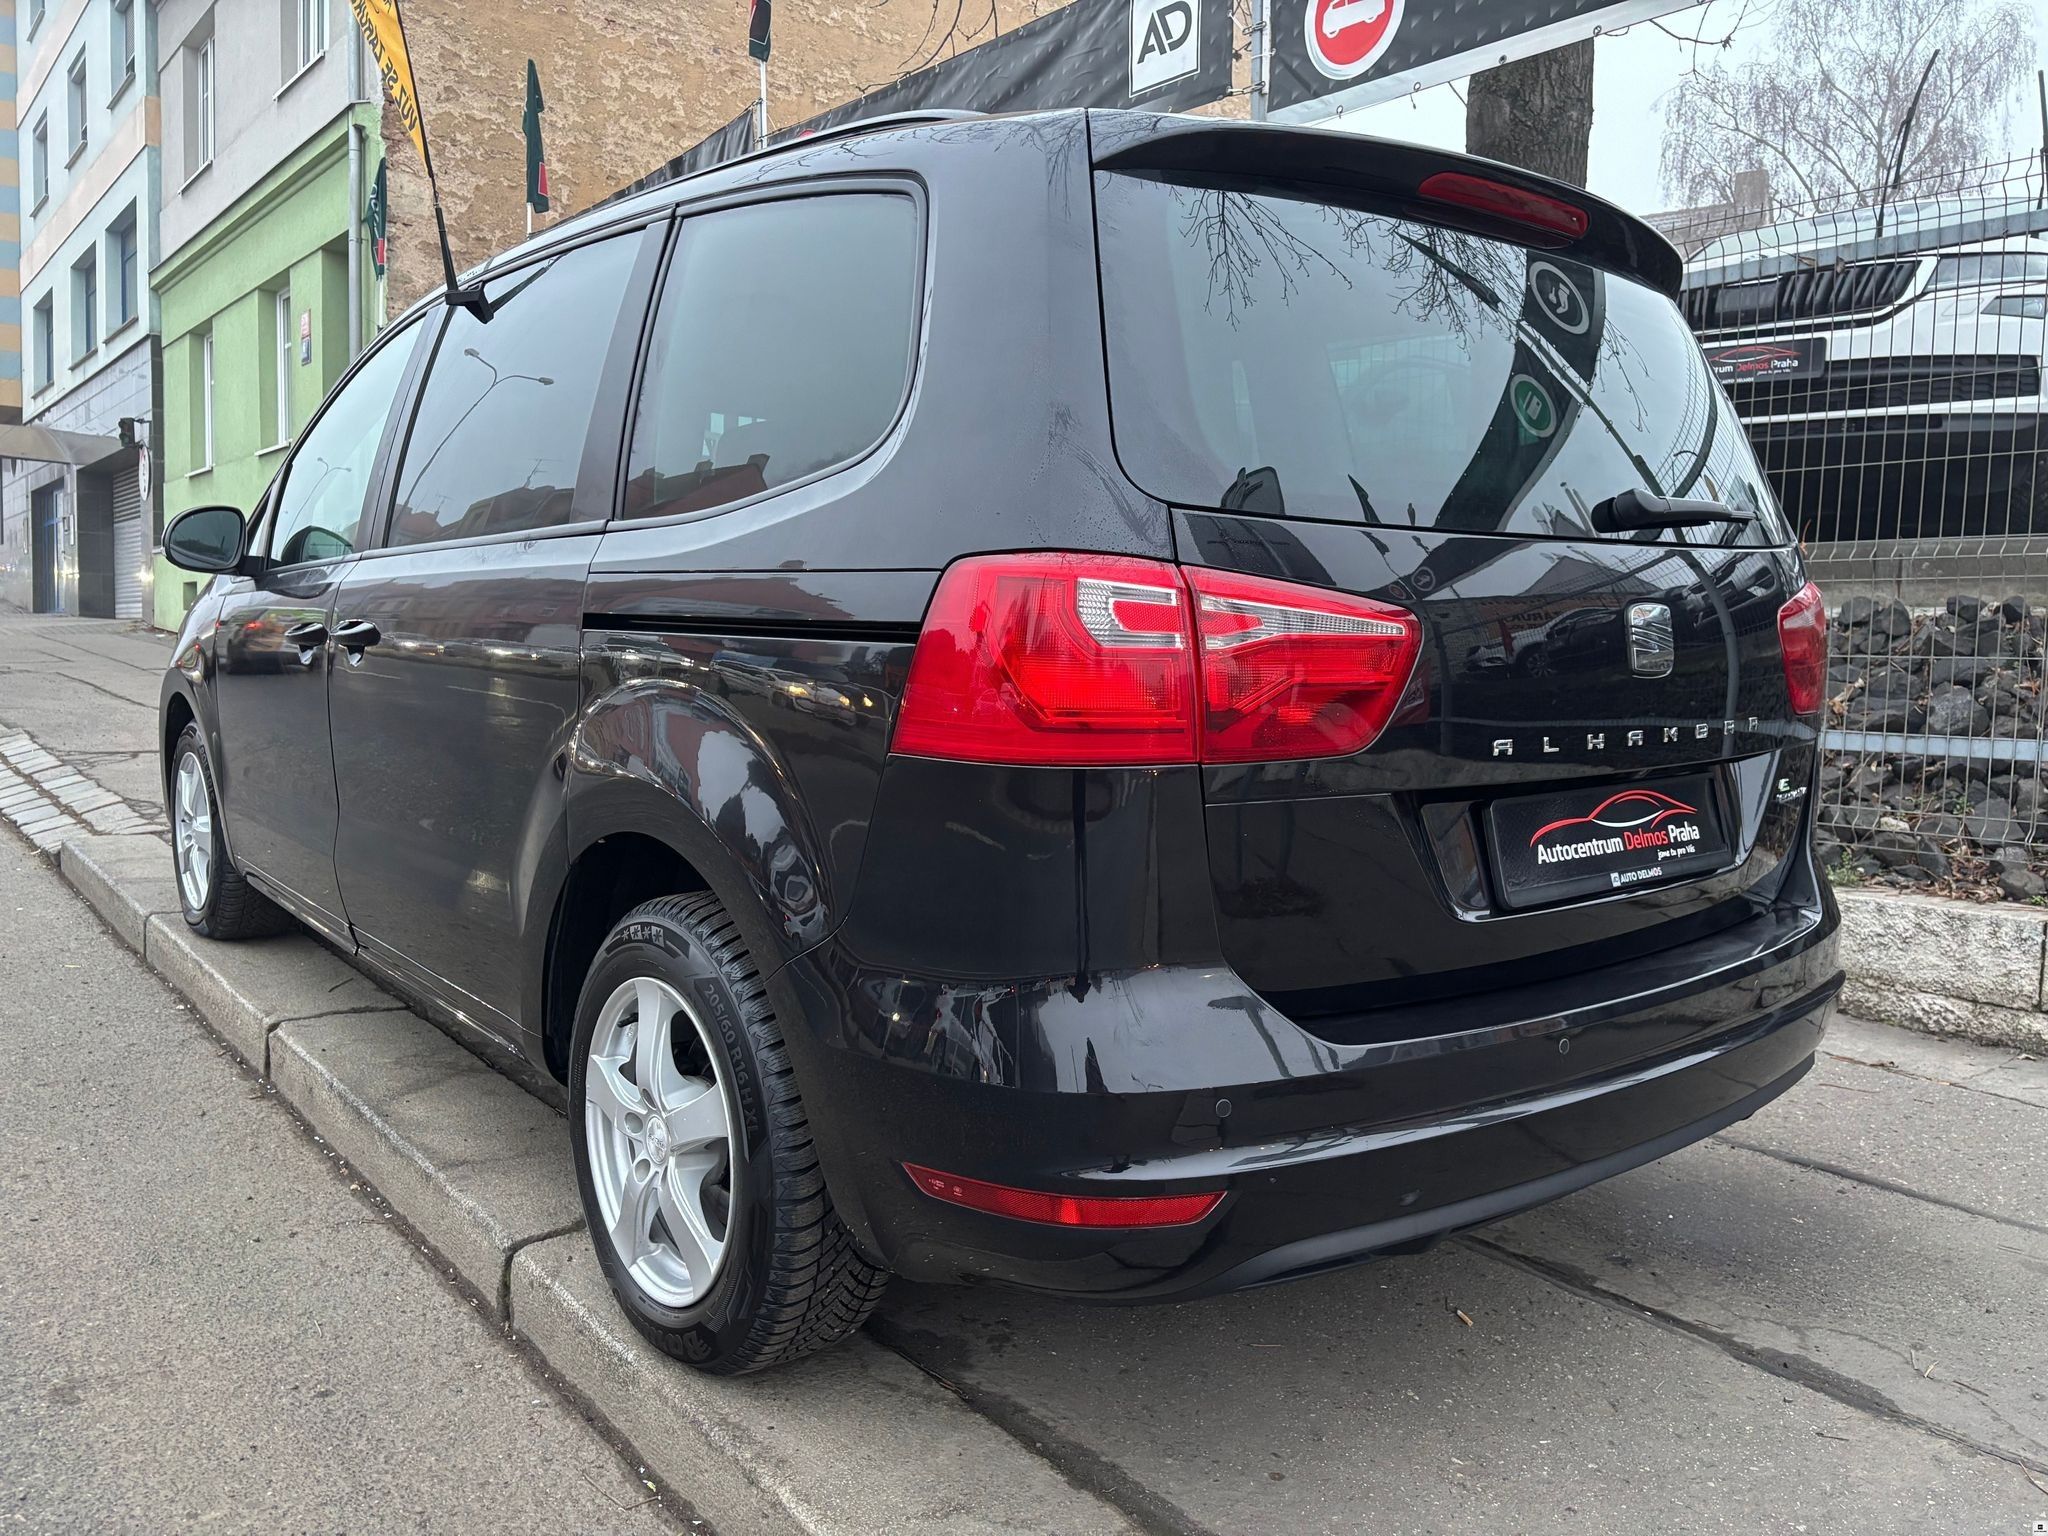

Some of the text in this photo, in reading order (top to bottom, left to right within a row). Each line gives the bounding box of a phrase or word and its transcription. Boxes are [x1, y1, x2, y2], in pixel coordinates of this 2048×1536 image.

[1137, 1, 1192, 64] AD
[1770, 358, 1799, 369] Praha
[1493, 716, 1758, 756] ALHAMBRA
[1537, 820, 1701, 865] Autocentrum Delmos Praha
[1620, 871, 1637, 883] AUTO
[1637, 866, 1663, 880] DELMOS
[704, 983, 736, 1044] 205/60
[730, 1048, 749, 1085] R16
